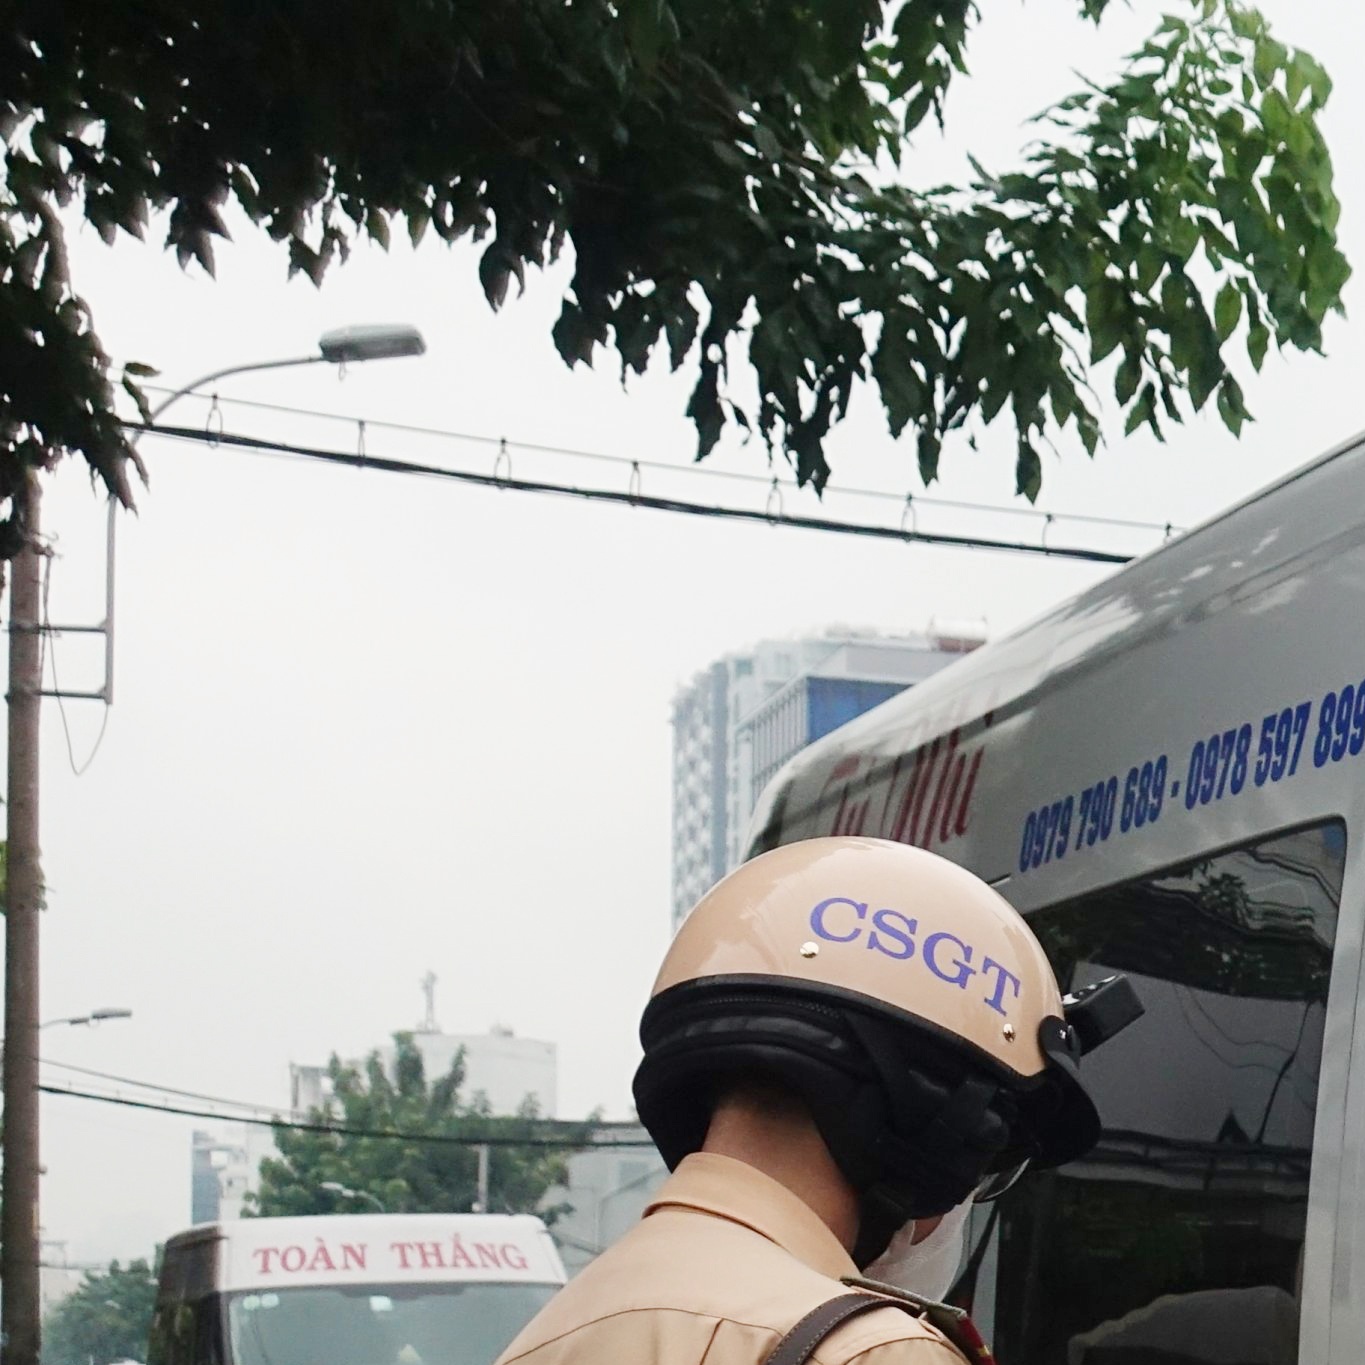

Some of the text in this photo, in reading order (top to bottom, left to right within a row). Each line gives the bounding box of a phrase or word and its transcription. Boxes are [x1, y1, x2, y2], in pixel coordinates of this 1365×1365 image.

[1019, 795, 1074, 873] 0979
[1075, 776, 1118, 851] 790
[1120, 754, 1168, 833] 689
[1185, 722, 1253, 811] 0978
[1254, 701, 1312, 787] 597
[810, 897, 1021, 1017] CSGT
[253, 1236, 368, 1274] TOÀN
